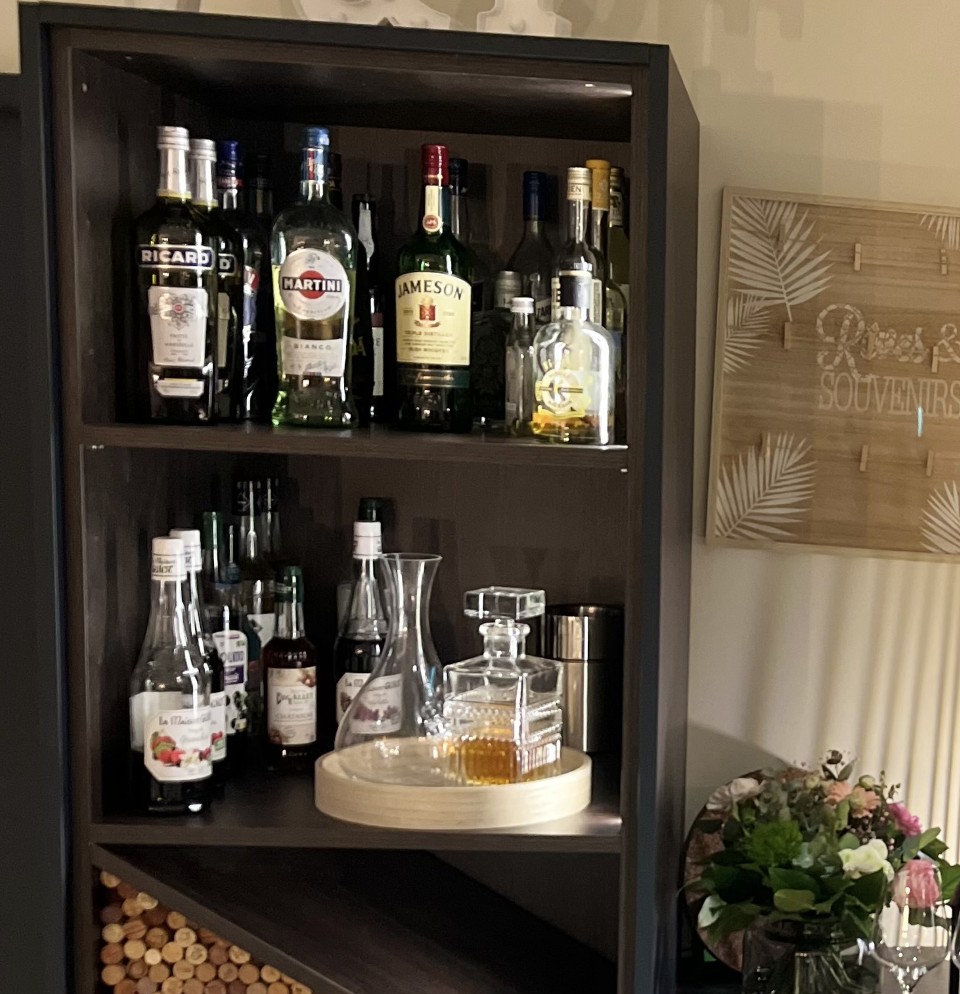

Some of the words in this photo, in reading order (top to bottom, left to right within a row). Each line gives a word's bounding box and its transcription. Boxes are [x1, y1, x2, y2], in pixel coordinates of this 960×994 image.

[141, 249, 210, 265] RICARD
[283, 278, 341, 292] MARTINI
[398, 279, 464, 300] JAMESON
[294, 343, 332, 351] BIANCO
